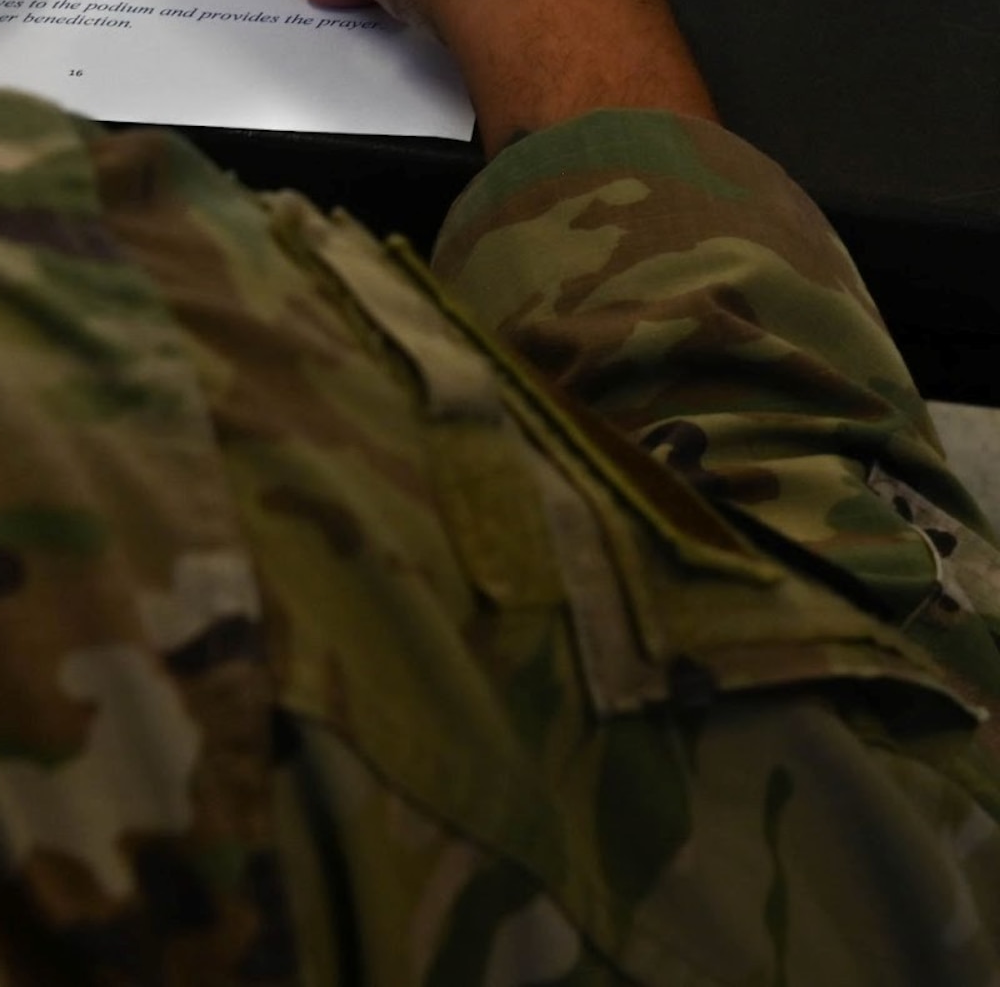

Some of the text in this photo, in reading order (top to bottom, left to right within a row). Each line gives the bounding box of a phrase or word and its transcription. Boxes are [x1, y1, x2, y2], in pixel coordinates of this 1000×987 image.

[29, 0, 48, 9] to
[52, 0, 80, 11] the
[84, 1, 154, 15] podium
[160, 7, 199, 18] and
[199, 11, 279, 23] provides
[284, 13, 313, 25] the
[23, 14, 132, 29] benediction.
[69, 69, 83, 77] 16
